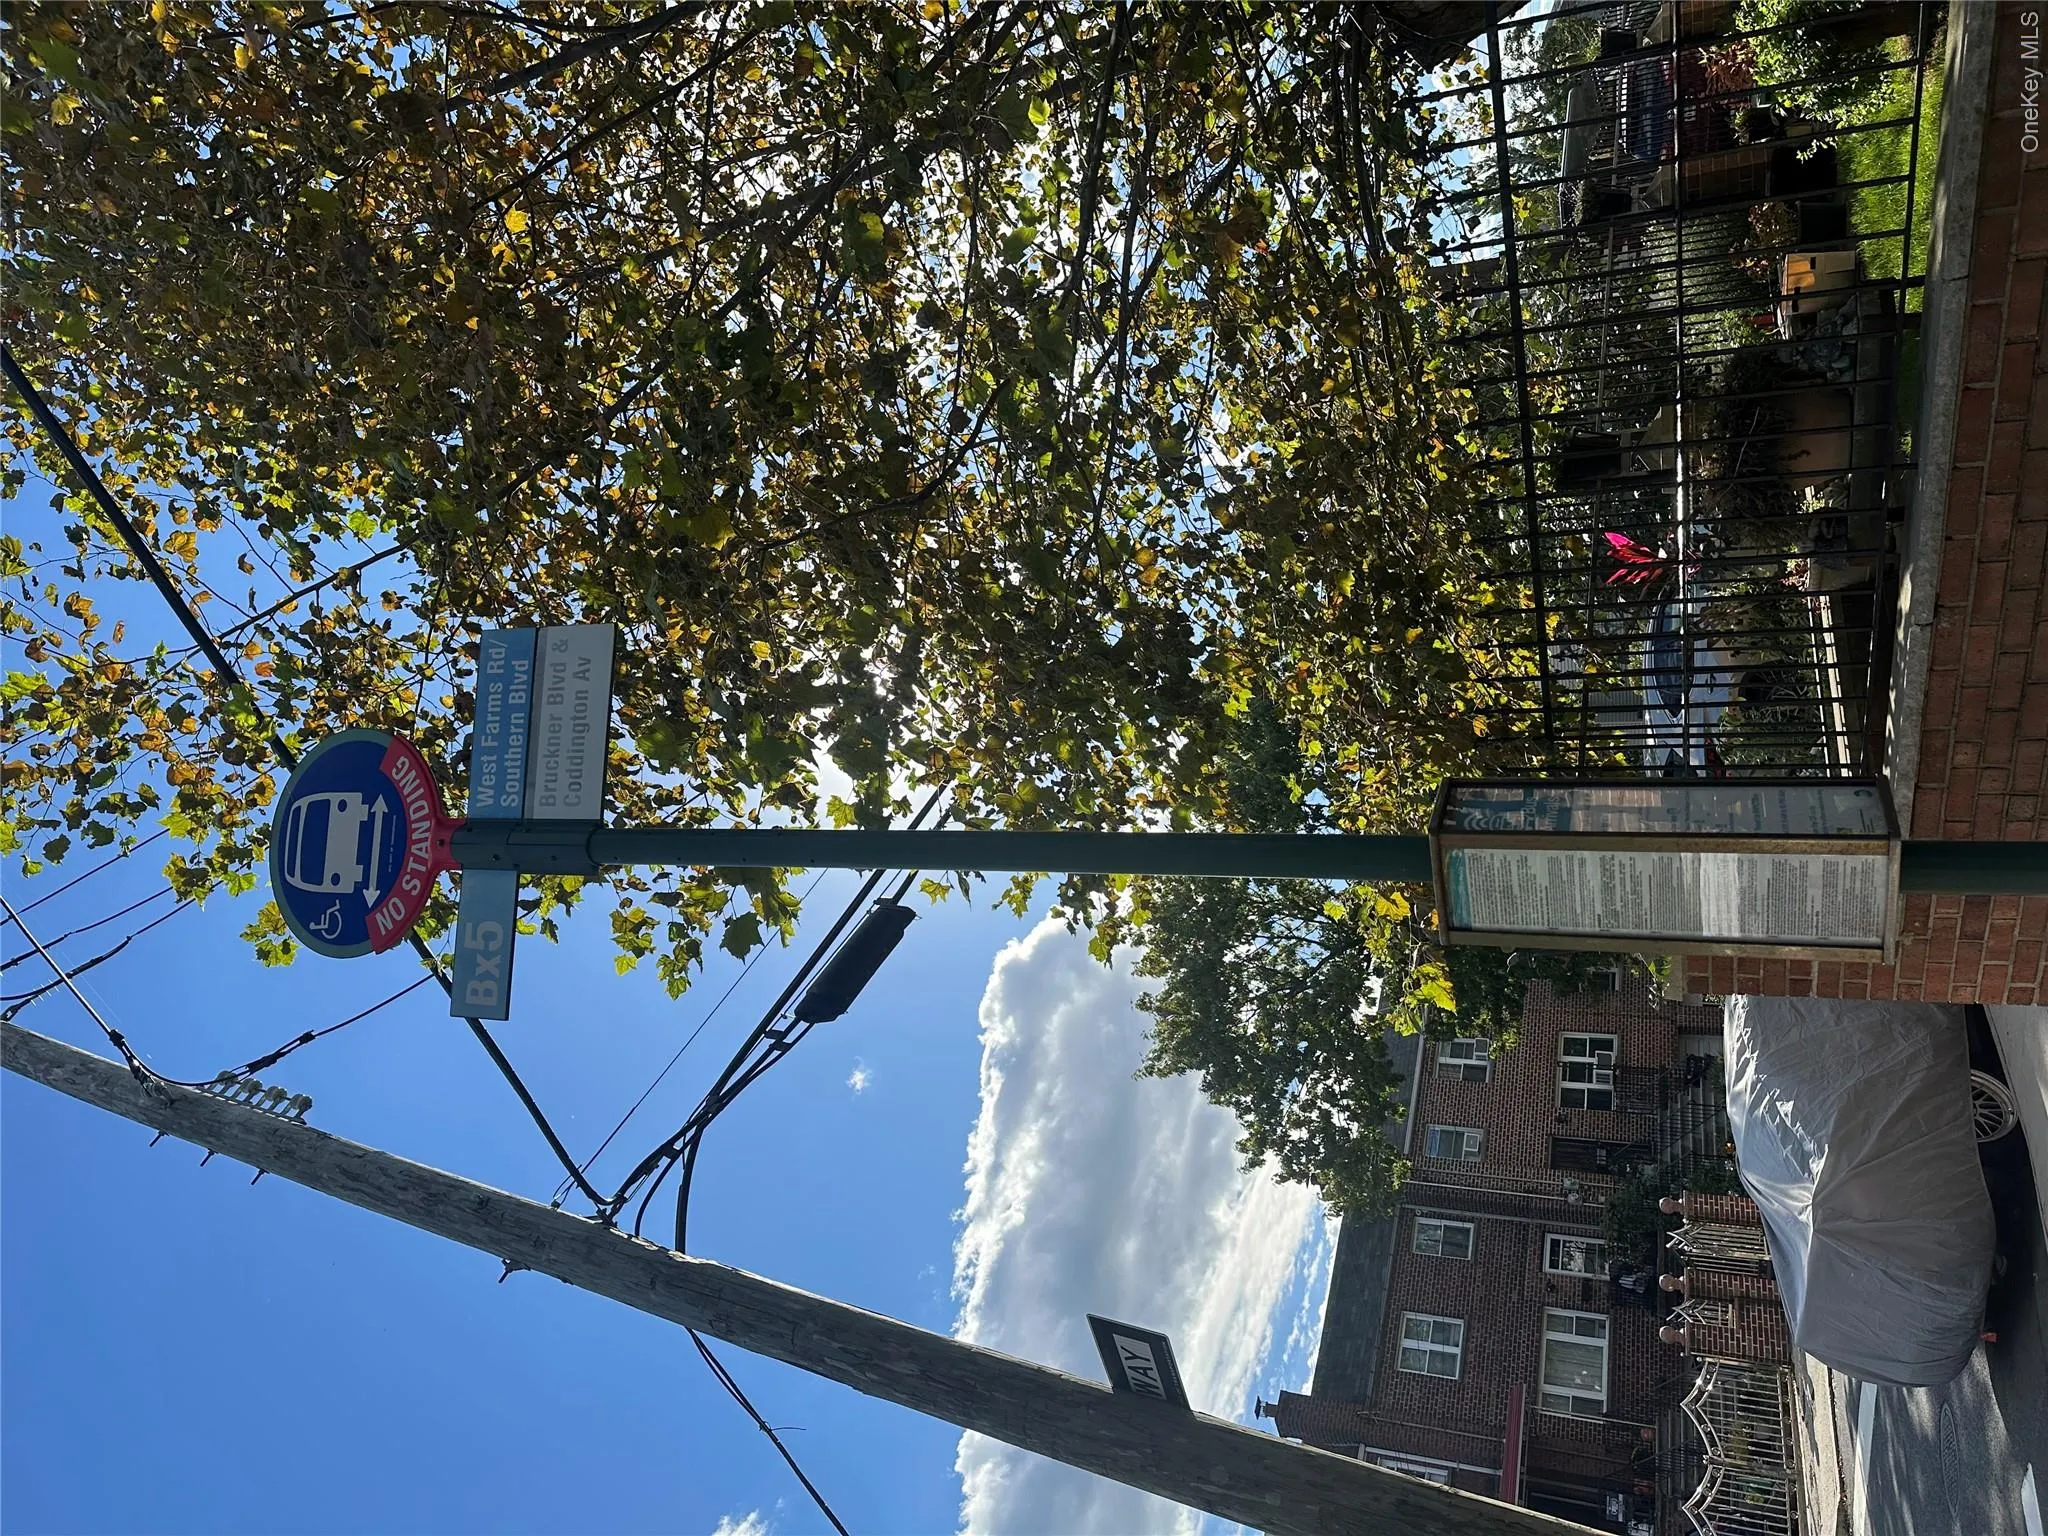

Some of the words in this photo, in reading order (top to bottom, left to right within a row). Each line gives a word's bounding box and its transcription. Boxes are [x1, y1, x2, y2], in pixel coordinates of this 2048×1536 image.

[485, 639, 508, 676] Rd/
[550, 638, 569, 653] &
[572, 656, 592, 683] Av
[509, 659, 529, 705] Blvd
[547, 661, 567, 706] Blvd
[481, 682, 503, 747] Farms
[500, 712, 525, 808] Southern
[539, 713, 563, 808] Bruckner
[563, 688, 590, 808] Coddington
[475, 754, 498, 808] West
[1521, 796, 1537, 814] Bus
[1540, 796, 1560, 831] Arrivals
[373, 896, 406, 937] NO
[390, 754, 432, 897] STANDING
[464, 920, 504, 1008] Bx5
[1121, 1346, 1162, 1396] WAY
